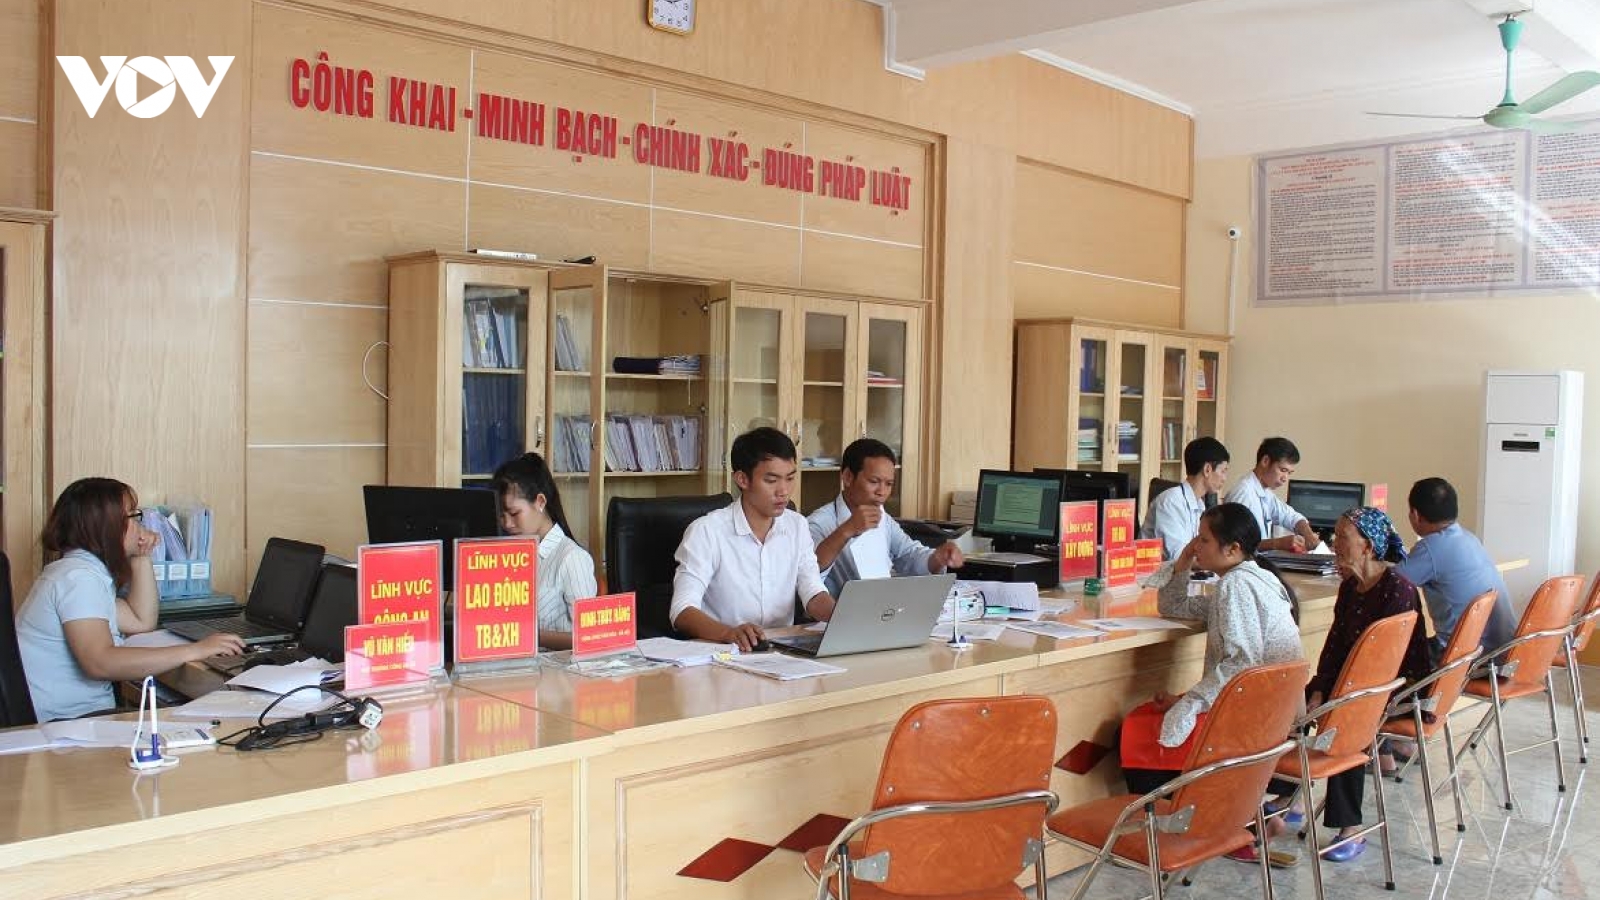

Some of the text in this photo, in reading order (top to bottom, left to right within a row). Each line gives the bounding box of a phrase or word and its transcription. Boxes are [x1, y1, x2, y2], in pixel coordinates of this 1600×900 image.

[290, 51, 375, 119] CÔNG
[388, 76, 457, 133] KHAI
[478, 92, 546, 146] MINH
[555, 106, 618, 163] BẠCH
[634, 118, 701, 174] CHÍNH
[709, 130, 749, 182] XÁC
[763, 142, 814, 194] ĐÚNG
[820, 155, 866, 202] PHÁP
[871, 166, 911, 216] LUẬT
[468, 550, 530, 573] LĨNH VỰC
[371, 578, 433, 600] LĨNH VỰC
[465, 576, 531, 613] LAO ĐỘNG
[476, 622, 520, 650] TB&XH
